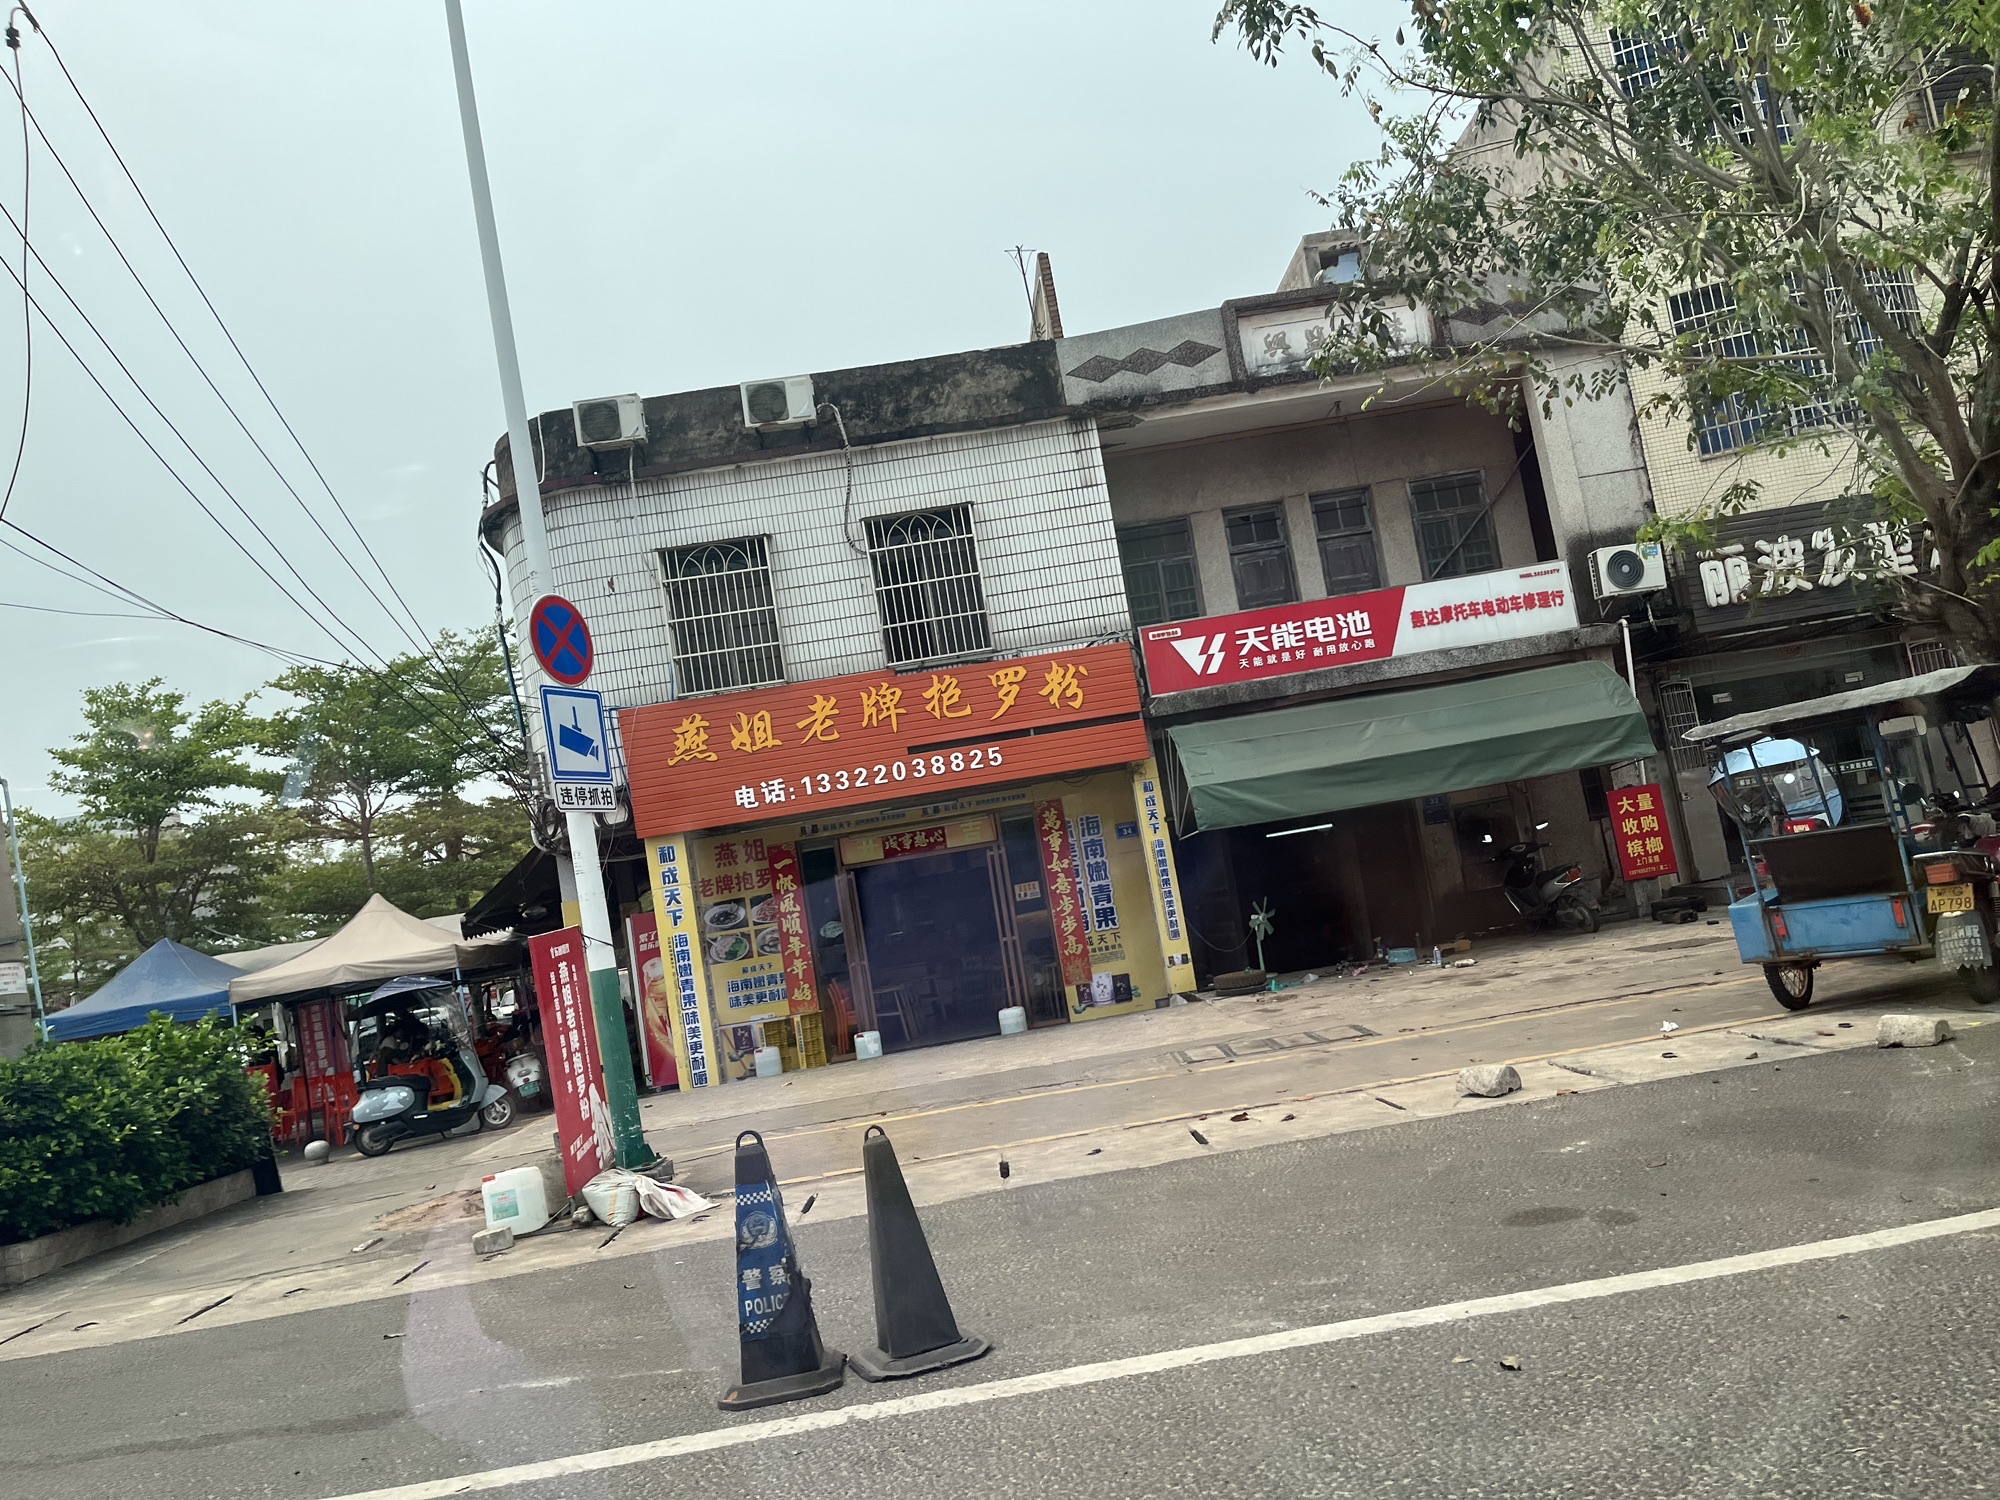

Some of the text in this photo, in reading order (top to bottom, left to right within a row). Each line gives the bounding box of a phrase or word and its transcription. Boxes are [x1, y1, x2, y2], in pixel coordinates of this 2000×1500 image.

[1234, 609, 1371, 656] 天能电池
[1238, 637, 1376, 669] 天能就是好 耐用放心跑
[667, 660, 1091, 766] 燕姐老牌抱罗粉
[559, 785, 614, 807] 违停抓拍
[1143, 780, 1161, 835] 和成天下
[1617, 792, 1655, 815] 大量
[1621, 815, 1659, 836] 收购
[713, 837, 767, 869] 燕姐
[1626, 836, 1664, 858] 槟榔
[657, 845, 685, 928] 和成天下
[1079, 815, 1119, 930] 海南嫩青果
[1930, 897, 1972, 911] AP798
[674, 933, 697, 1009] 海南嫩青果
[741, 1263, 791, 1291] 警察
[744, 1292, 791, 1317] POLIC
